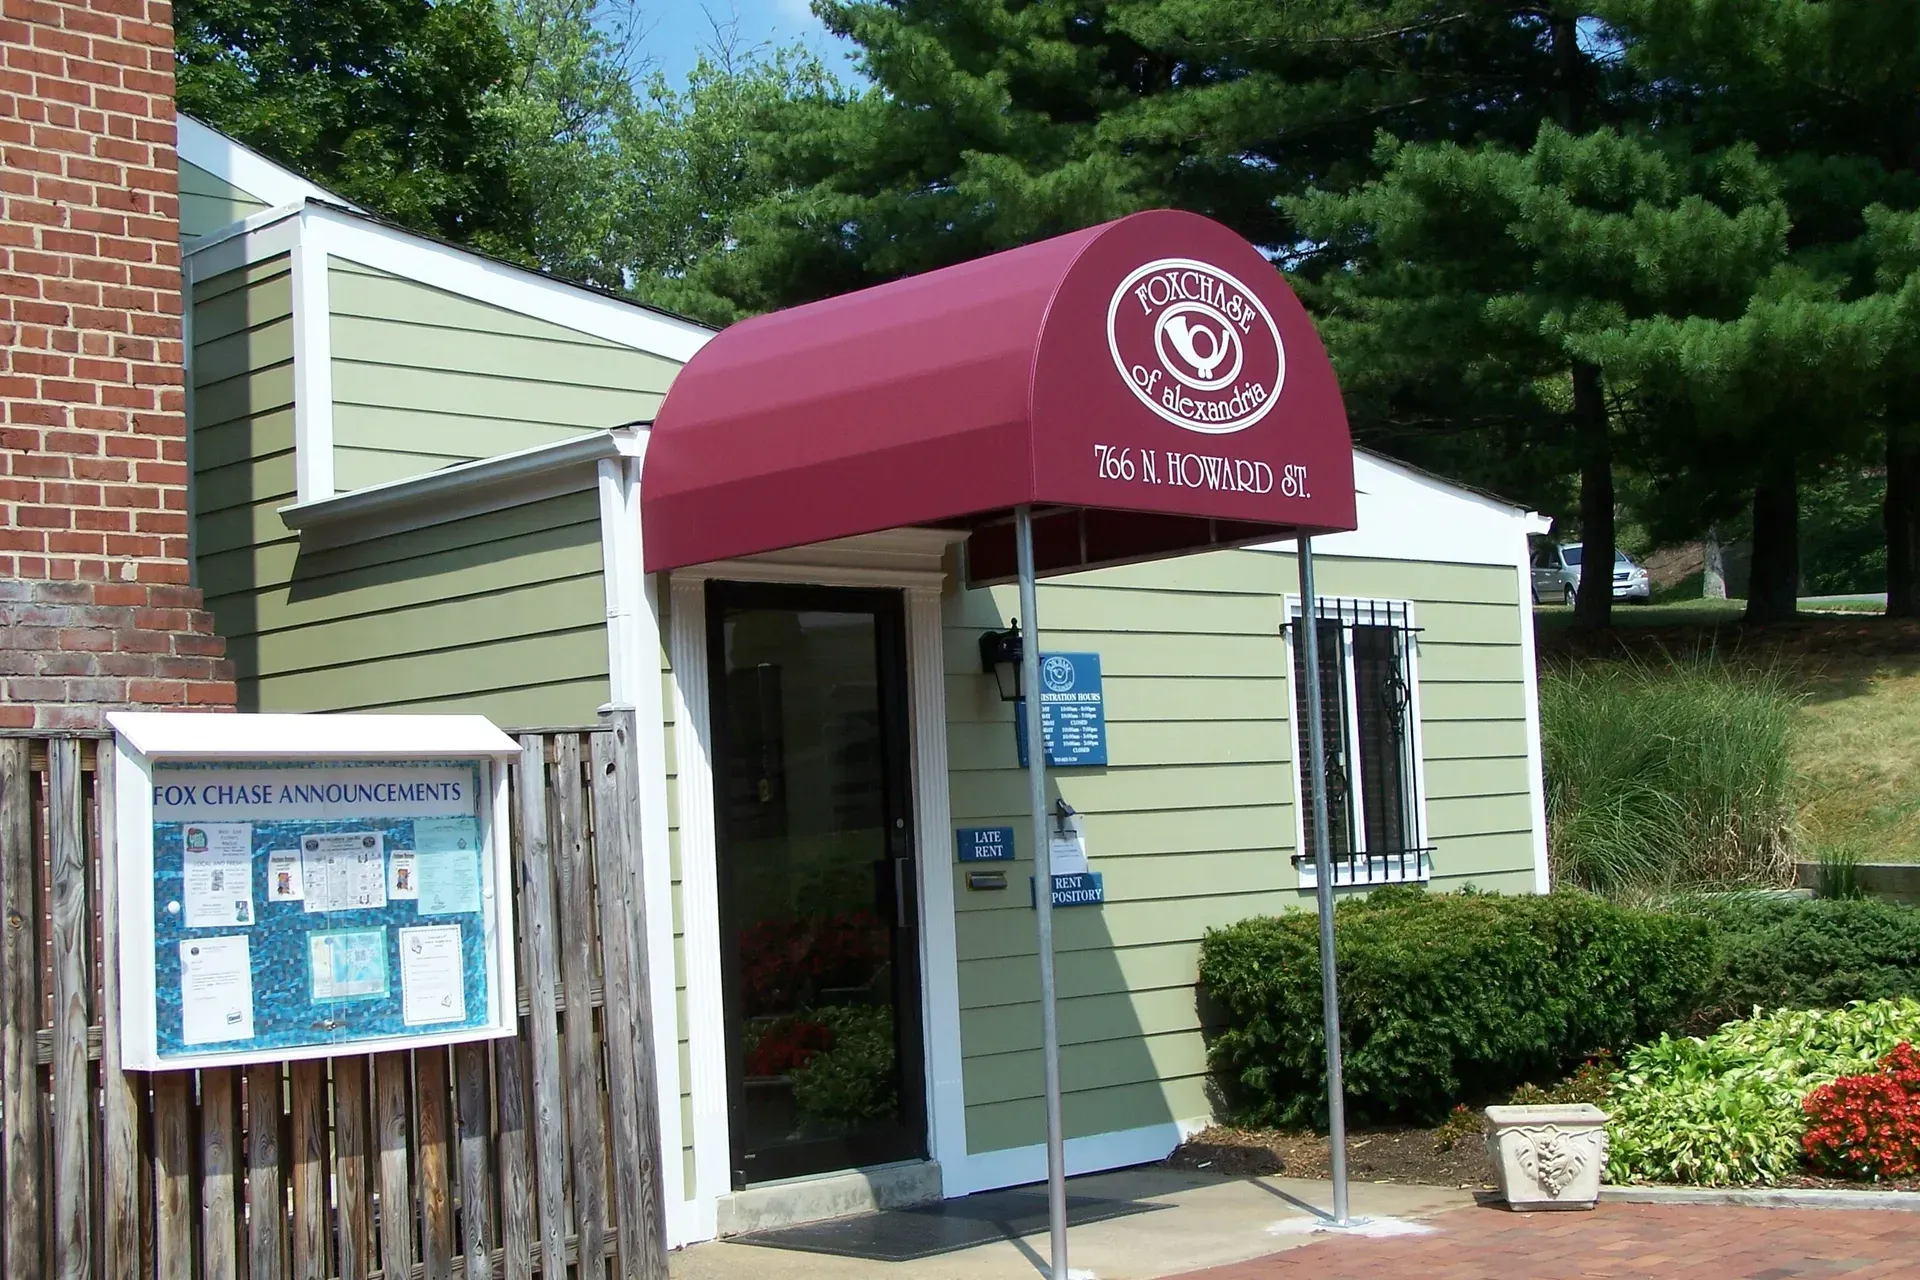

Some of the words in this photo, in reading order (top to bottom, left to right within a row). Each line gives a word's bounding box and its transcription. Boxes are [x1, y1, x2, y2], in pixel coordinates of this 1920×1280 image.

[1134, 271, 1256, 335] FOXCHASE
[1132, 364, 1162, 396] of
[1161, 382, 1268, 423] alexandria
[1093, 444, 1136, 481] 766
[1140, 449, 1162, 484] N.
[1166, 451, 1274, 494] HOWARD
[1280, 463, 1312, 498] ST.
[1078, 692, 1101, 701] HOURS
[152, 785, 197, 807] FOX
[202, 784, 273, 806] CHASE
[279, 782, 462, 804] ANNOUNCEMENTS
[975, 830, 1002, 843] LATE
[975, 845, 1004, 858] RENT
[1055, 876, 1083, 890] RENT
[1052, 888, 1102, 904] POSITORY
